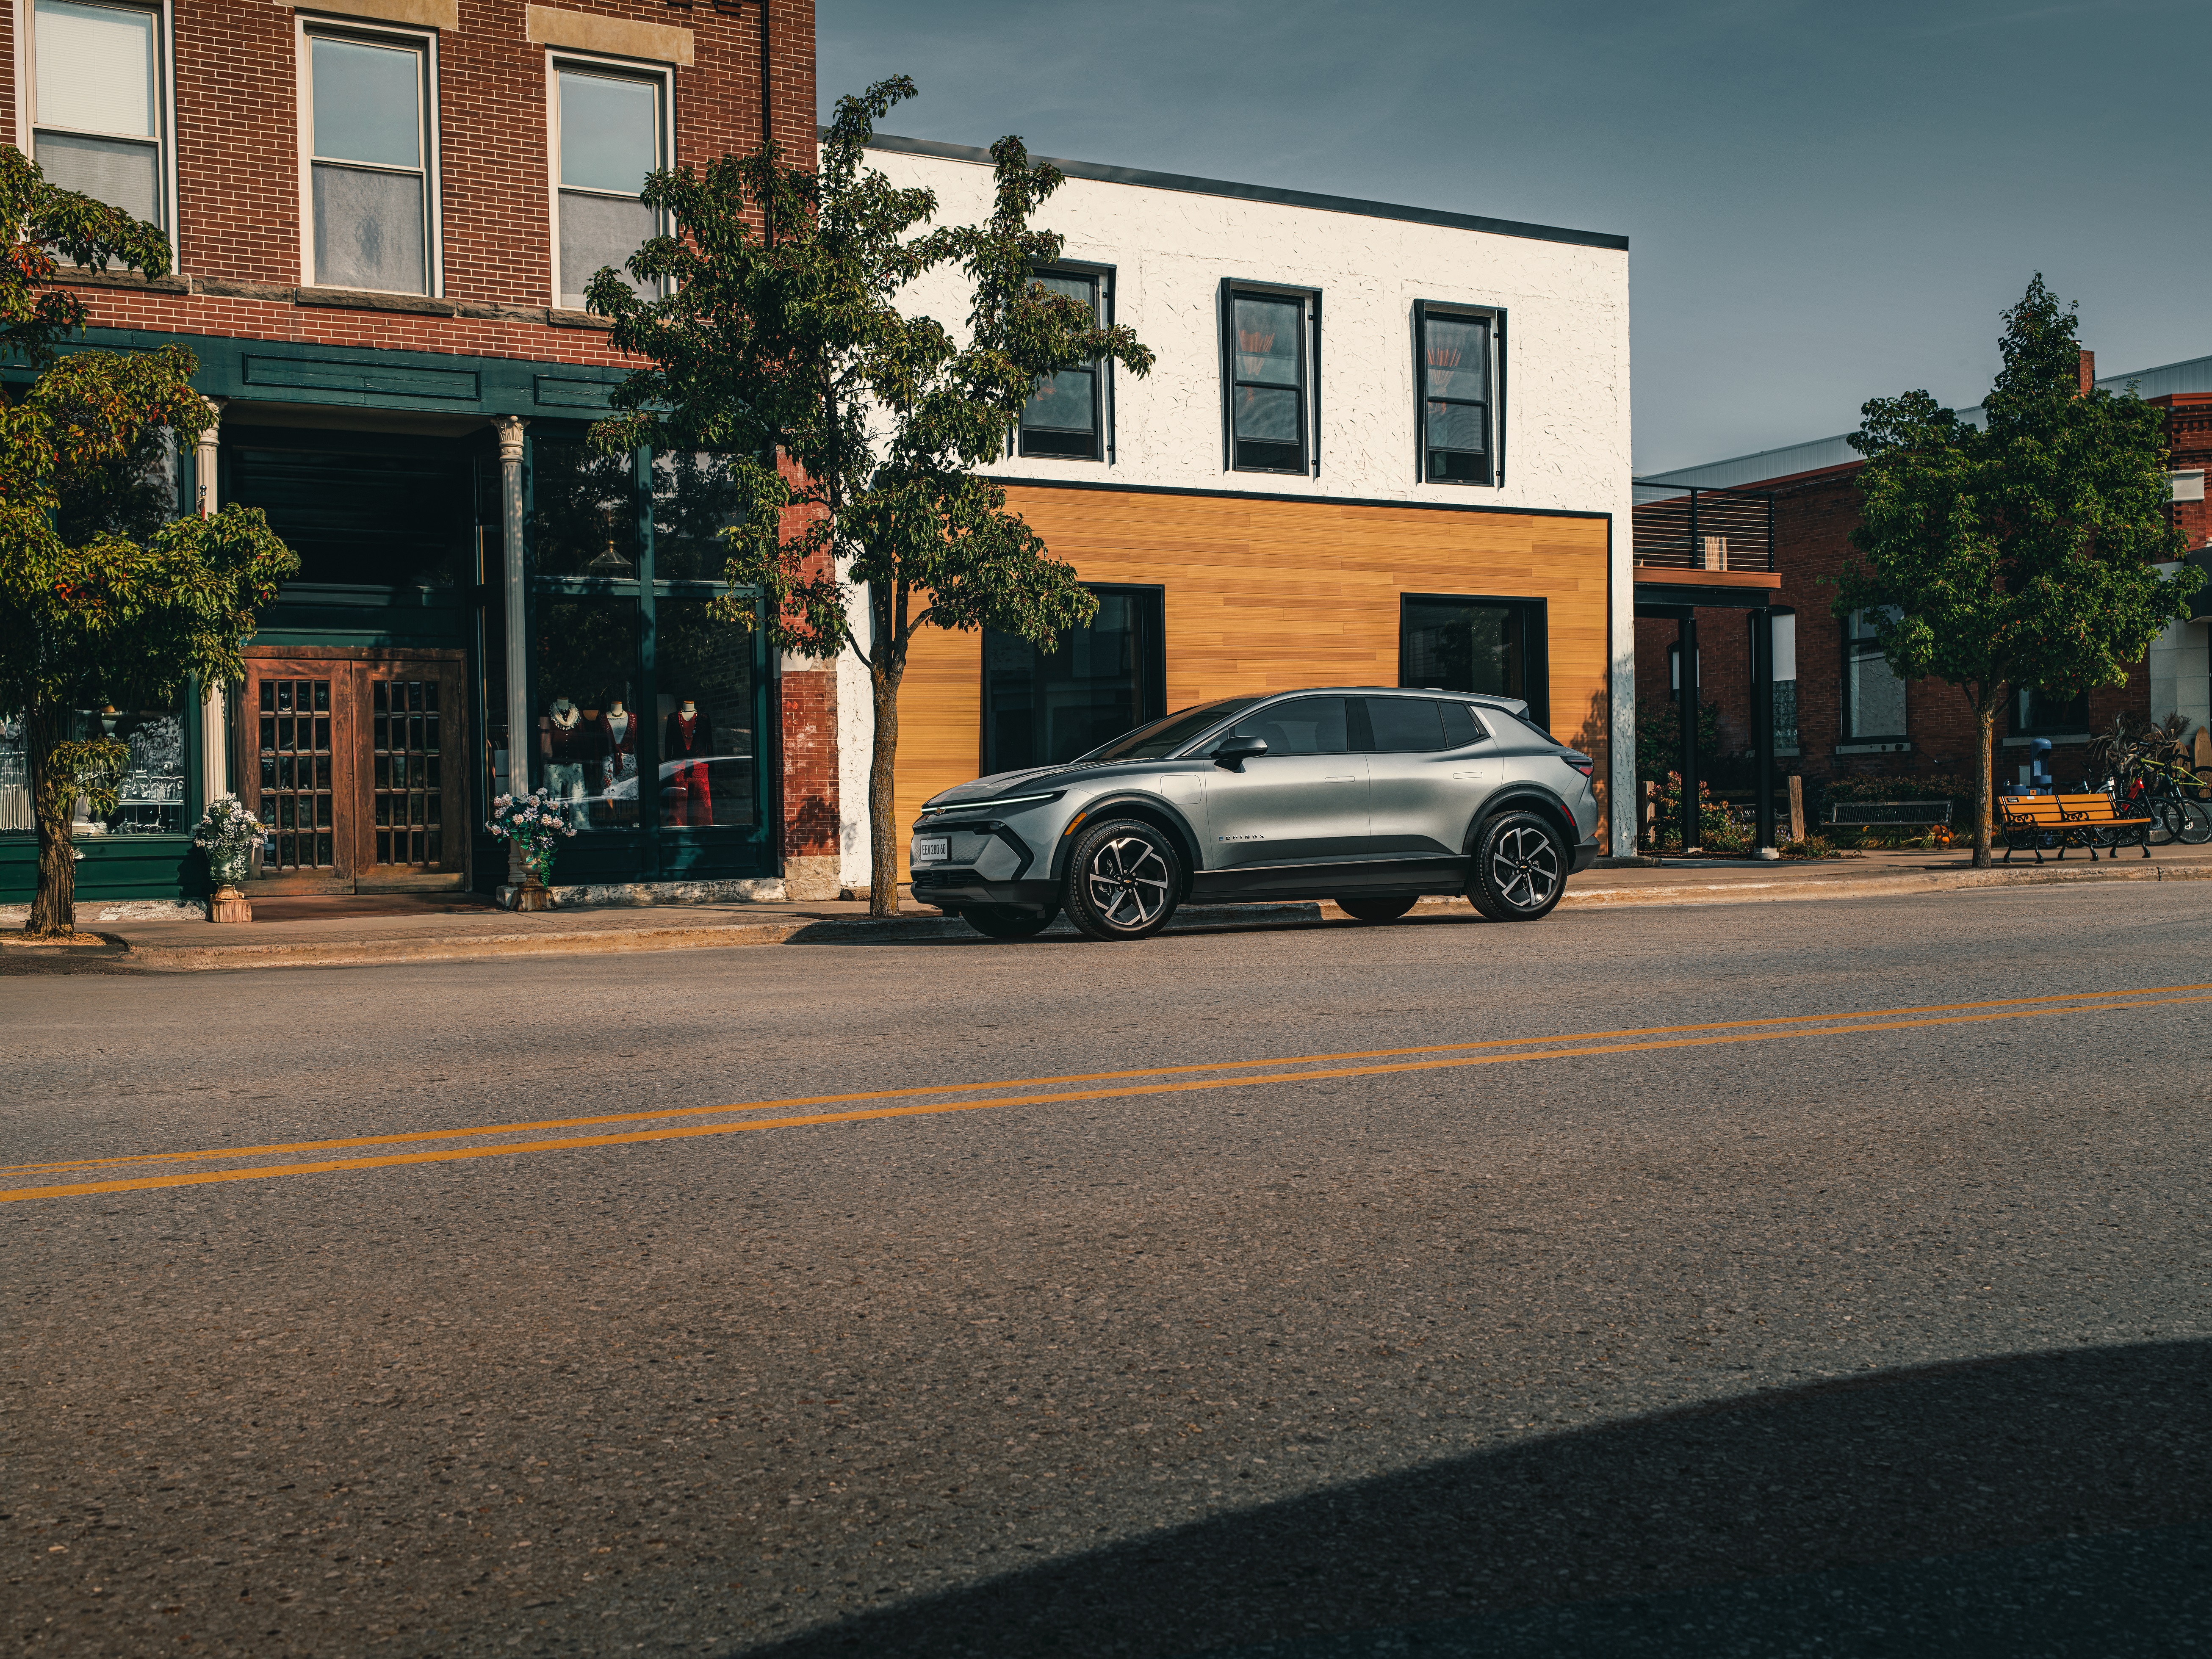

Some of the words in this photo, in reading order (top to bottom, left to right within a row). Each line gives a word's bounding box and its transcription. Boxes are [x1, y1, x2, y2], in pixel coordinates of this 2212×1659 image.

[1092, 828, 1120, 849] MICHELIN
[1548, 830, 1564, 857] MICHELIN
[922, 845, 930, 855] EEV
[931, 844, 939, 854] 280
[940, 844, 946, 854] 60
